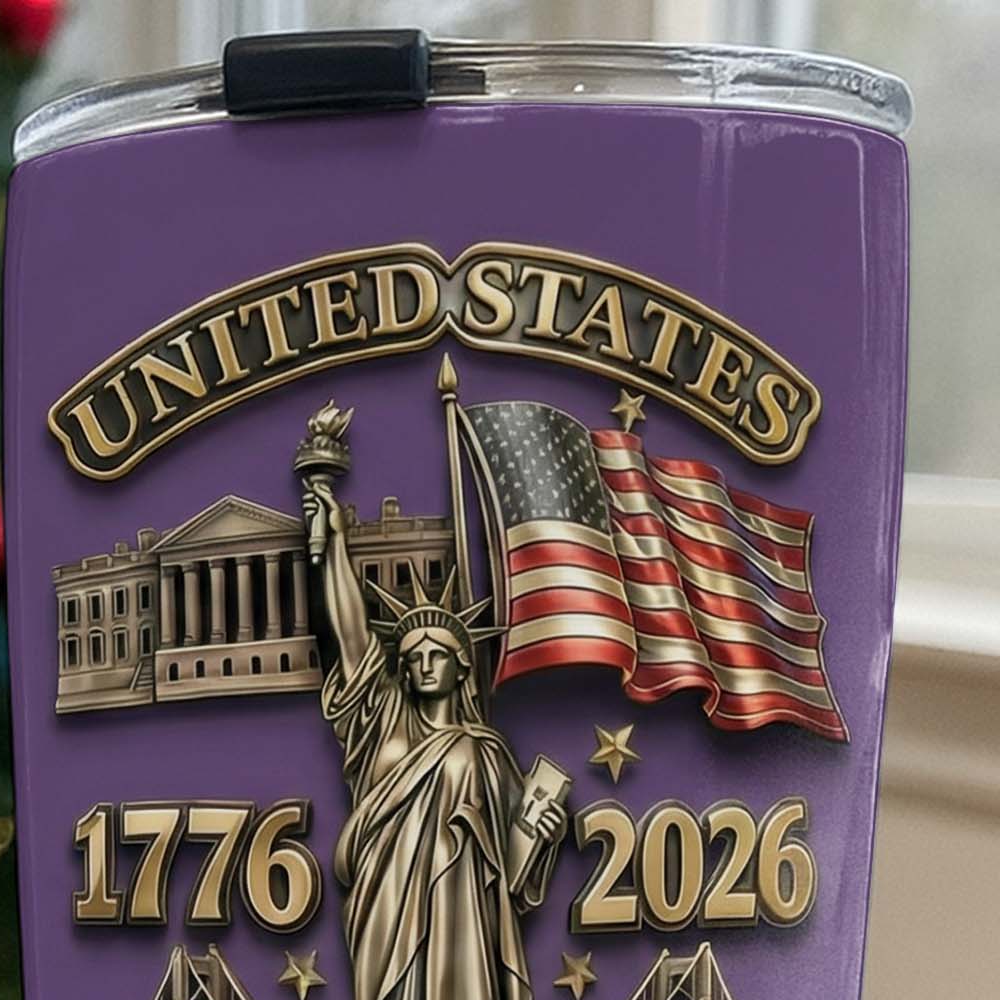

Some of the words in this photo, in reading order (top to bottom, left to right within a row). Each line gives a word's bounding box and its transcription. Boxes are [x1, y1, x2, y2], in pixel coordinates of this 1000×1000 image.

[68, 261, 439, 458] UNITED
[463, 259, 802, 445] STATES
[73, 802, 320, 928] 1776
[577, 801, 816, 930] 2026
